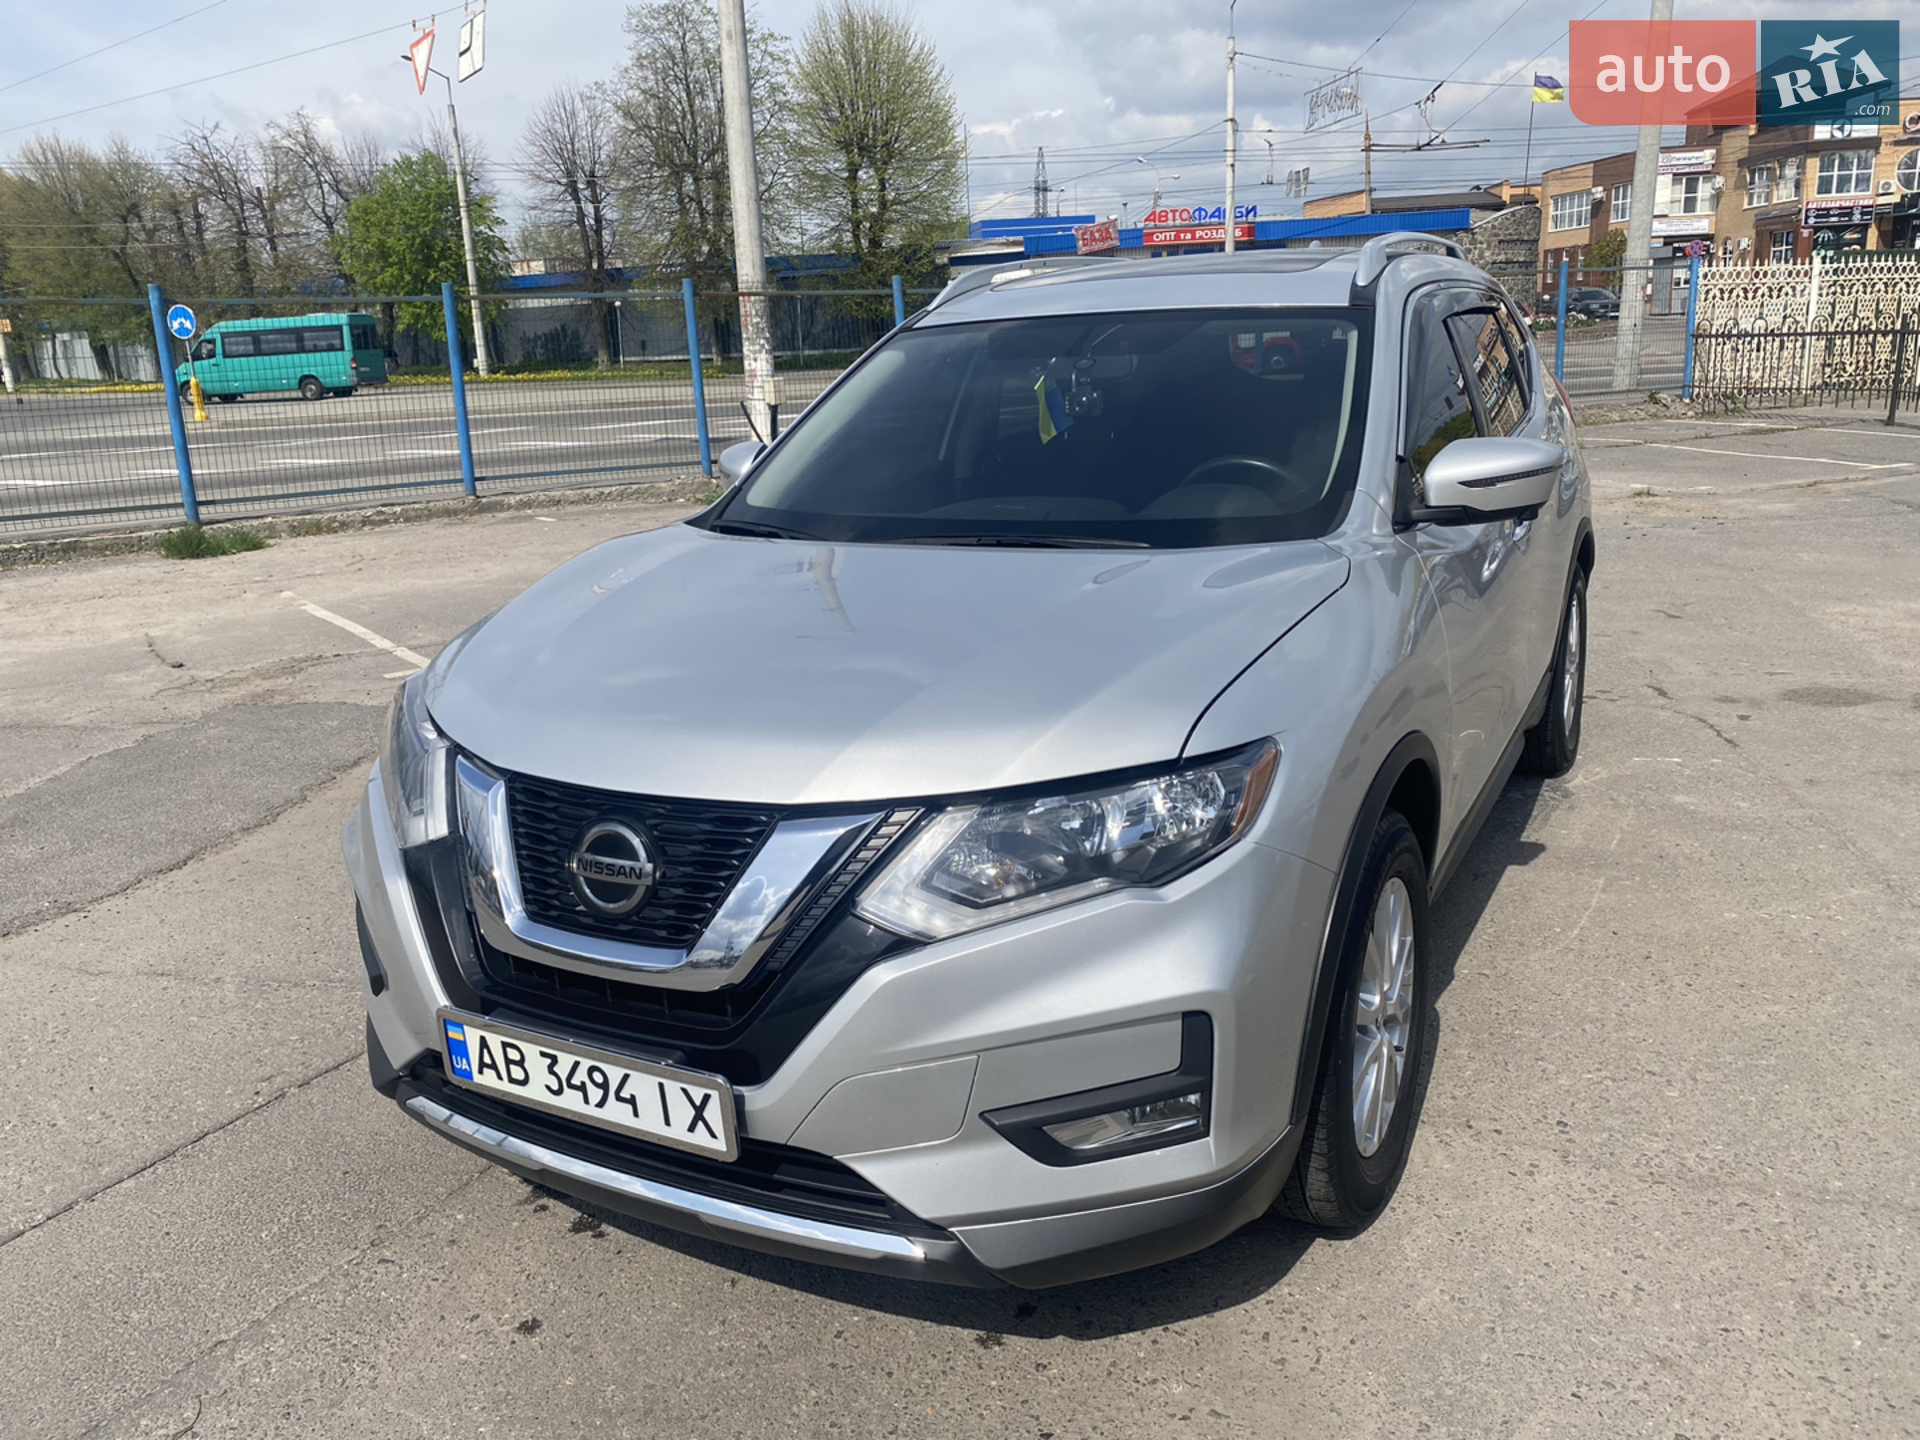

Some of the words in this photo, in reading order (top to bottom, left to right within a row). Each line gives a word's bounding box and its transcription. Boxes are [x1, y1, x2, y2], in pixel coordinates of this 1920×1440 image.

[1144, 205, 1258, 224] АВТОФАБИ
[1152, 231, 1176, 242] ОПТ
[1180, 232, 1192, 240] та
[1195, 227, 1243, 239] РОЗДБ
[575, 856, 643, 881] NISSAN
[452, 1054, 471, 1073] UA
[476, 1034, 530, 1088] AB
[539, 1050, 640, 1119] 3494
[657, 1081, 719, 1140] IX
